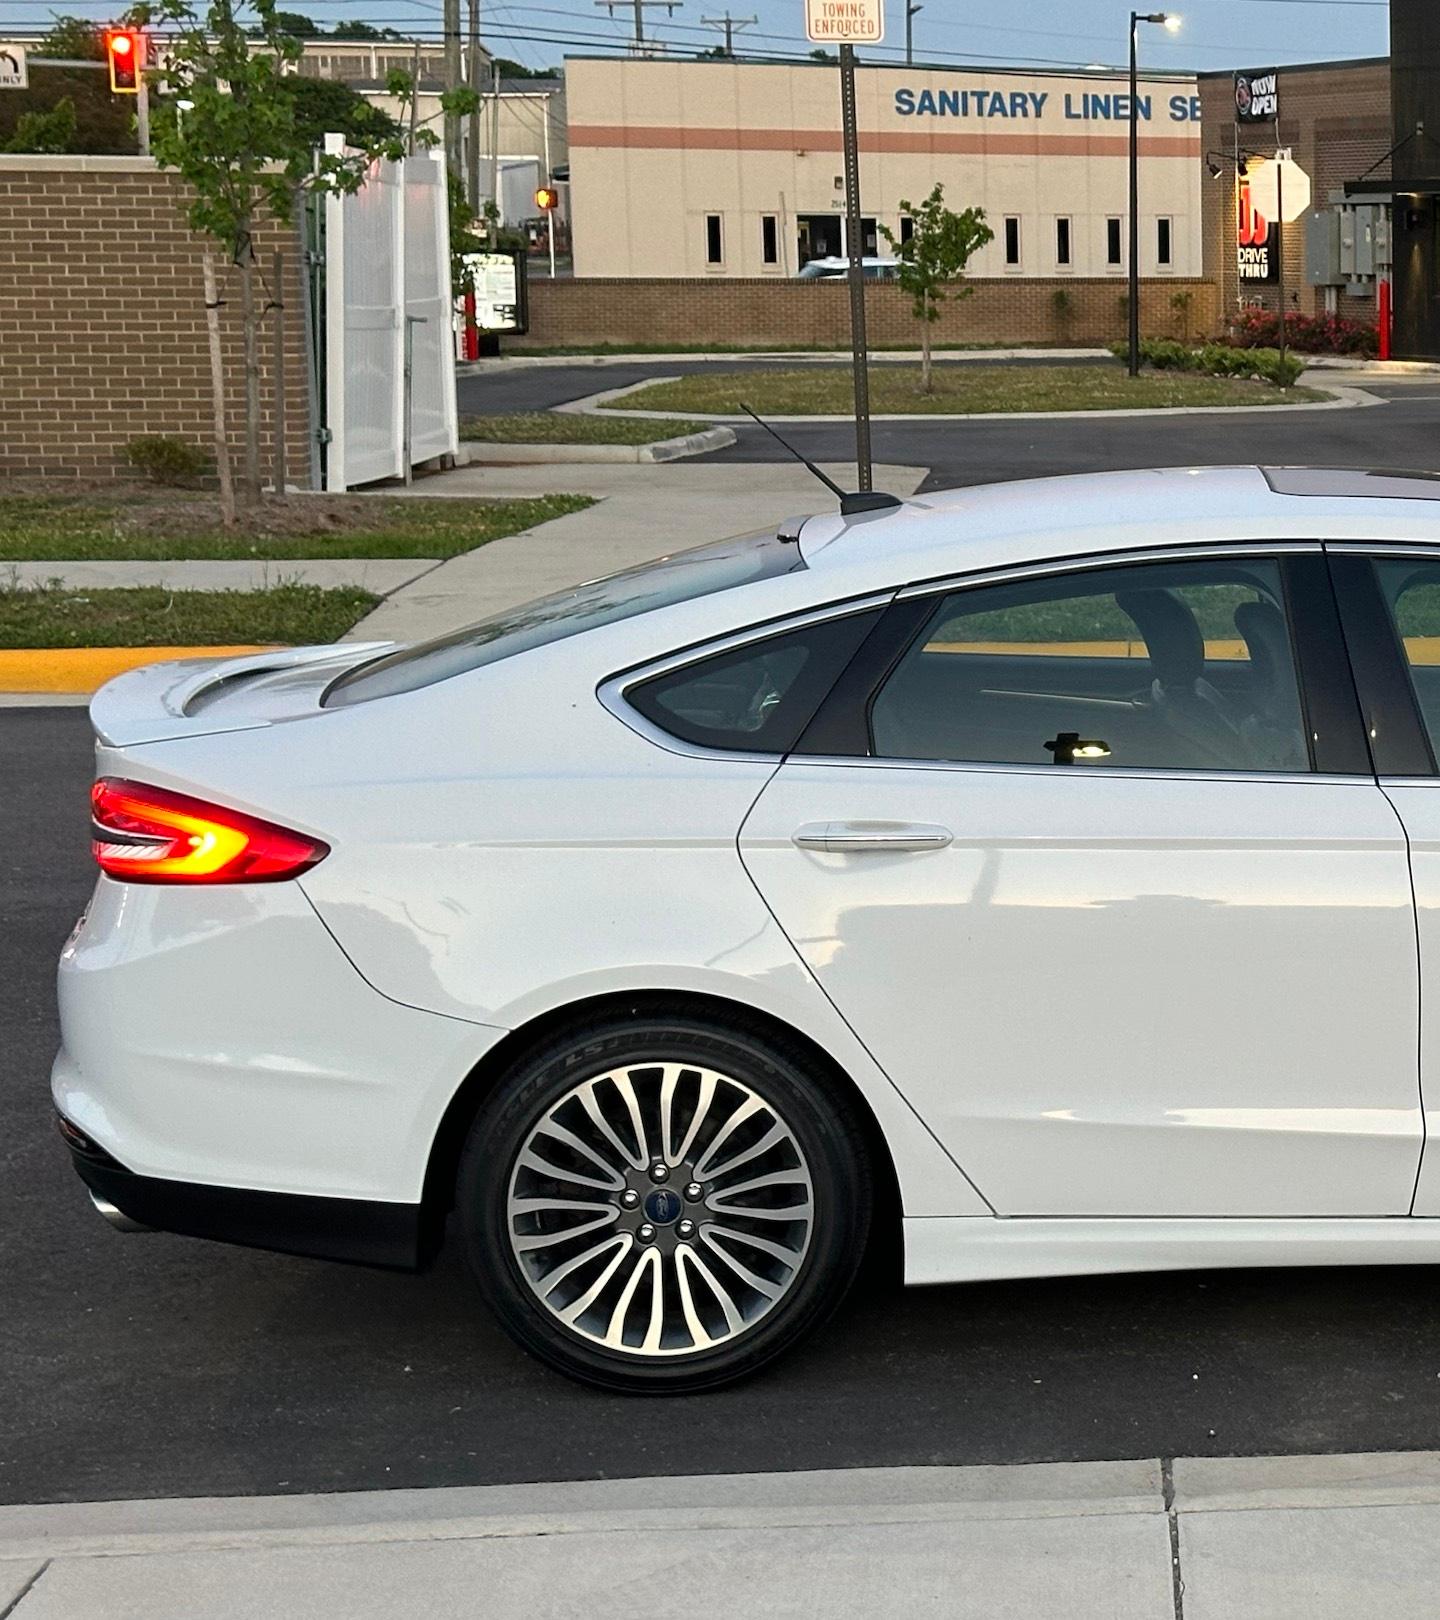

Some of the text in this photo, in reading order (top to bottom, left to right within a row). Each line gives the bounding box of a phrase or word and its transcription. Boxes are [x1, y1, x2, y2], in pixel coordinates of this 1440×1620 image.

[822, 2, 865, 18] TOWING
[814, 18, 875, 34] ENFORCED
[0, 75, 22, 84] NLY
[1251, 74, 1277, 95] NOW
[894, 88, 1048, 119] SANITARY
[1064, 92, 1152, 121] LINEN
[1251, 94, 1278, 115] OPEN
[1237, 247, 1269, 264] DRIVE
[1238, 263, 1269, 279] THRU
